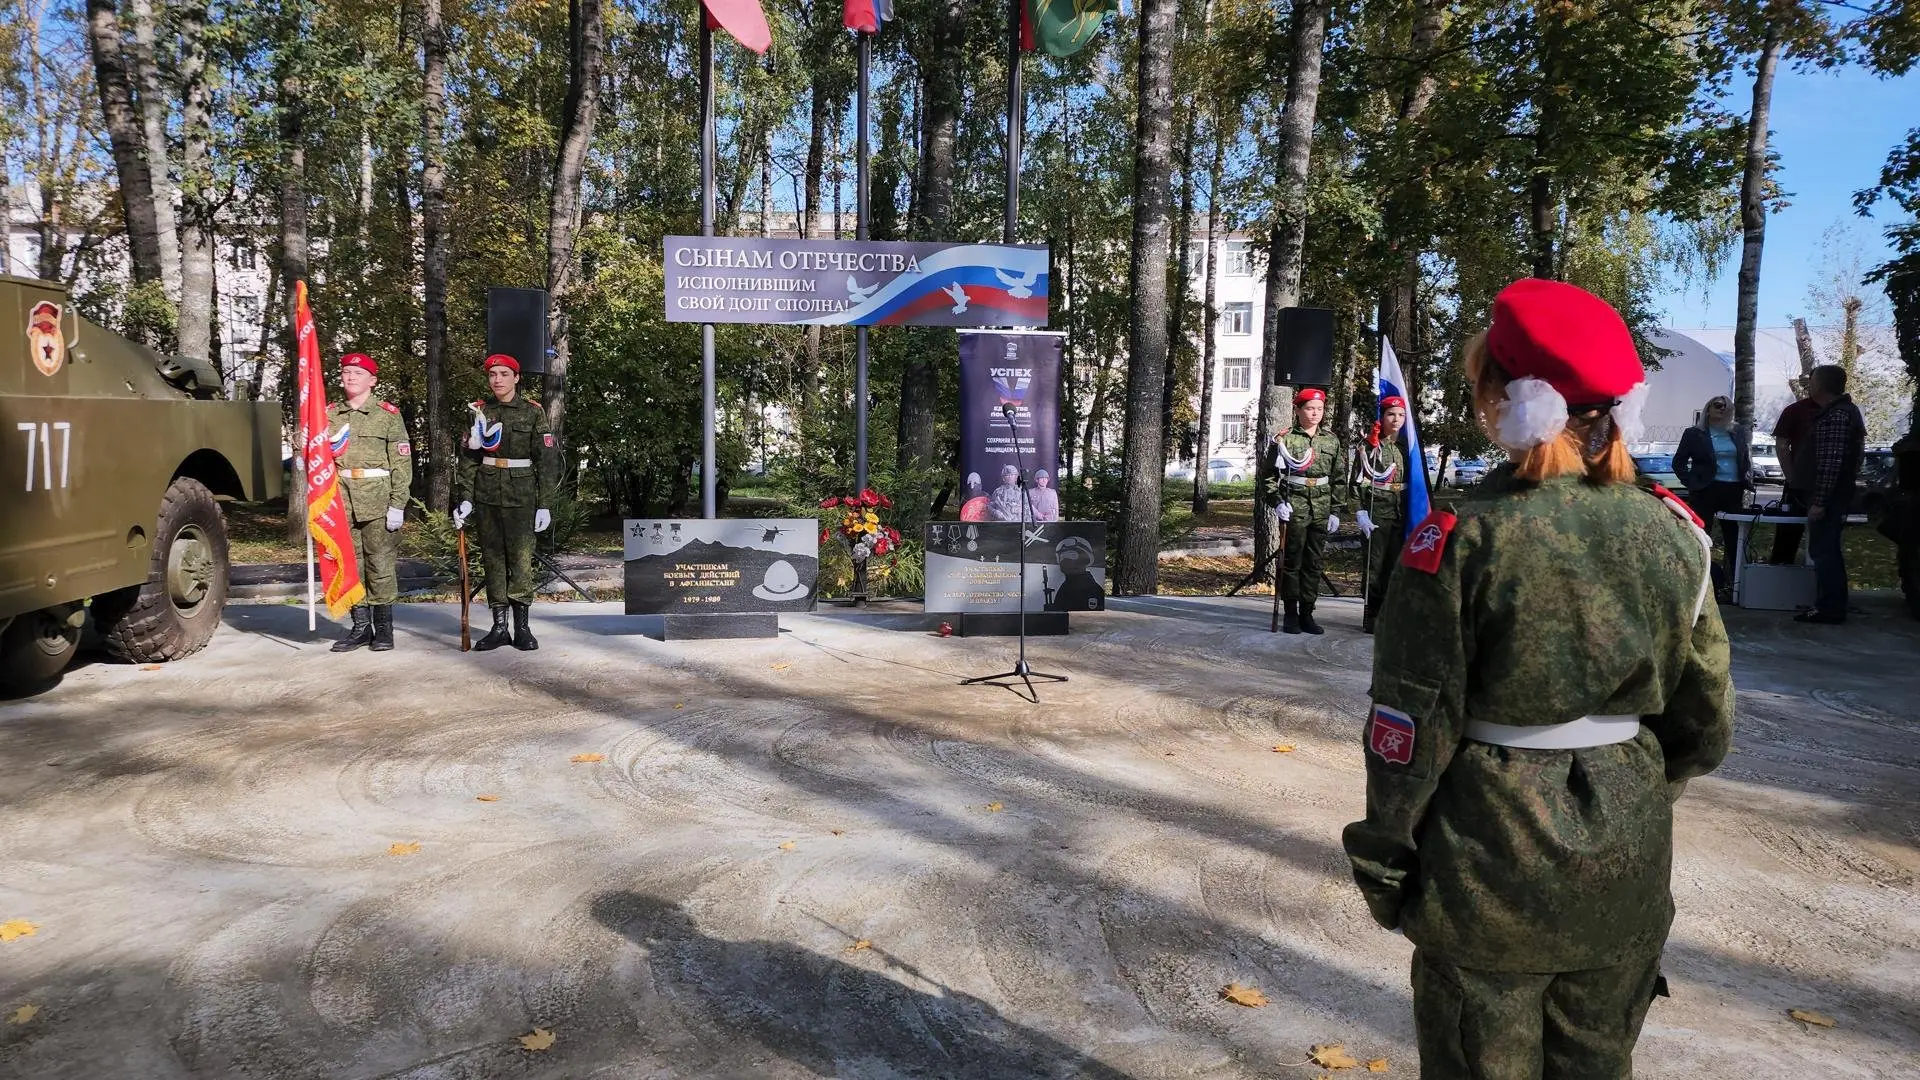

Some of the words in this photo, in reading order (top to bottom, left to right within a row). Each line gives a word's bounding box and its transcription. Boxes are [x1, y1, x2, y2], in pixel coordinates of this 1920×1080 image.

[674, 247, 773, 269] СЫНАМ
[779, 250, 922, 273] ОТЕЧЕСТВА
[677, 276, 816, 292] ИСПОЛНИВШИМ
[677, 294, 724, 310] СВОЙ
[728, 296, 772, 313] ДОЛГ
[774, 298, 849, 312] СПОЛНА!
[990, 367, 1032, 377] УСПЕХ
[17, 421, 71, 492] 717
[699, 570, 740, 579] ДЕЙСТВИЙ
